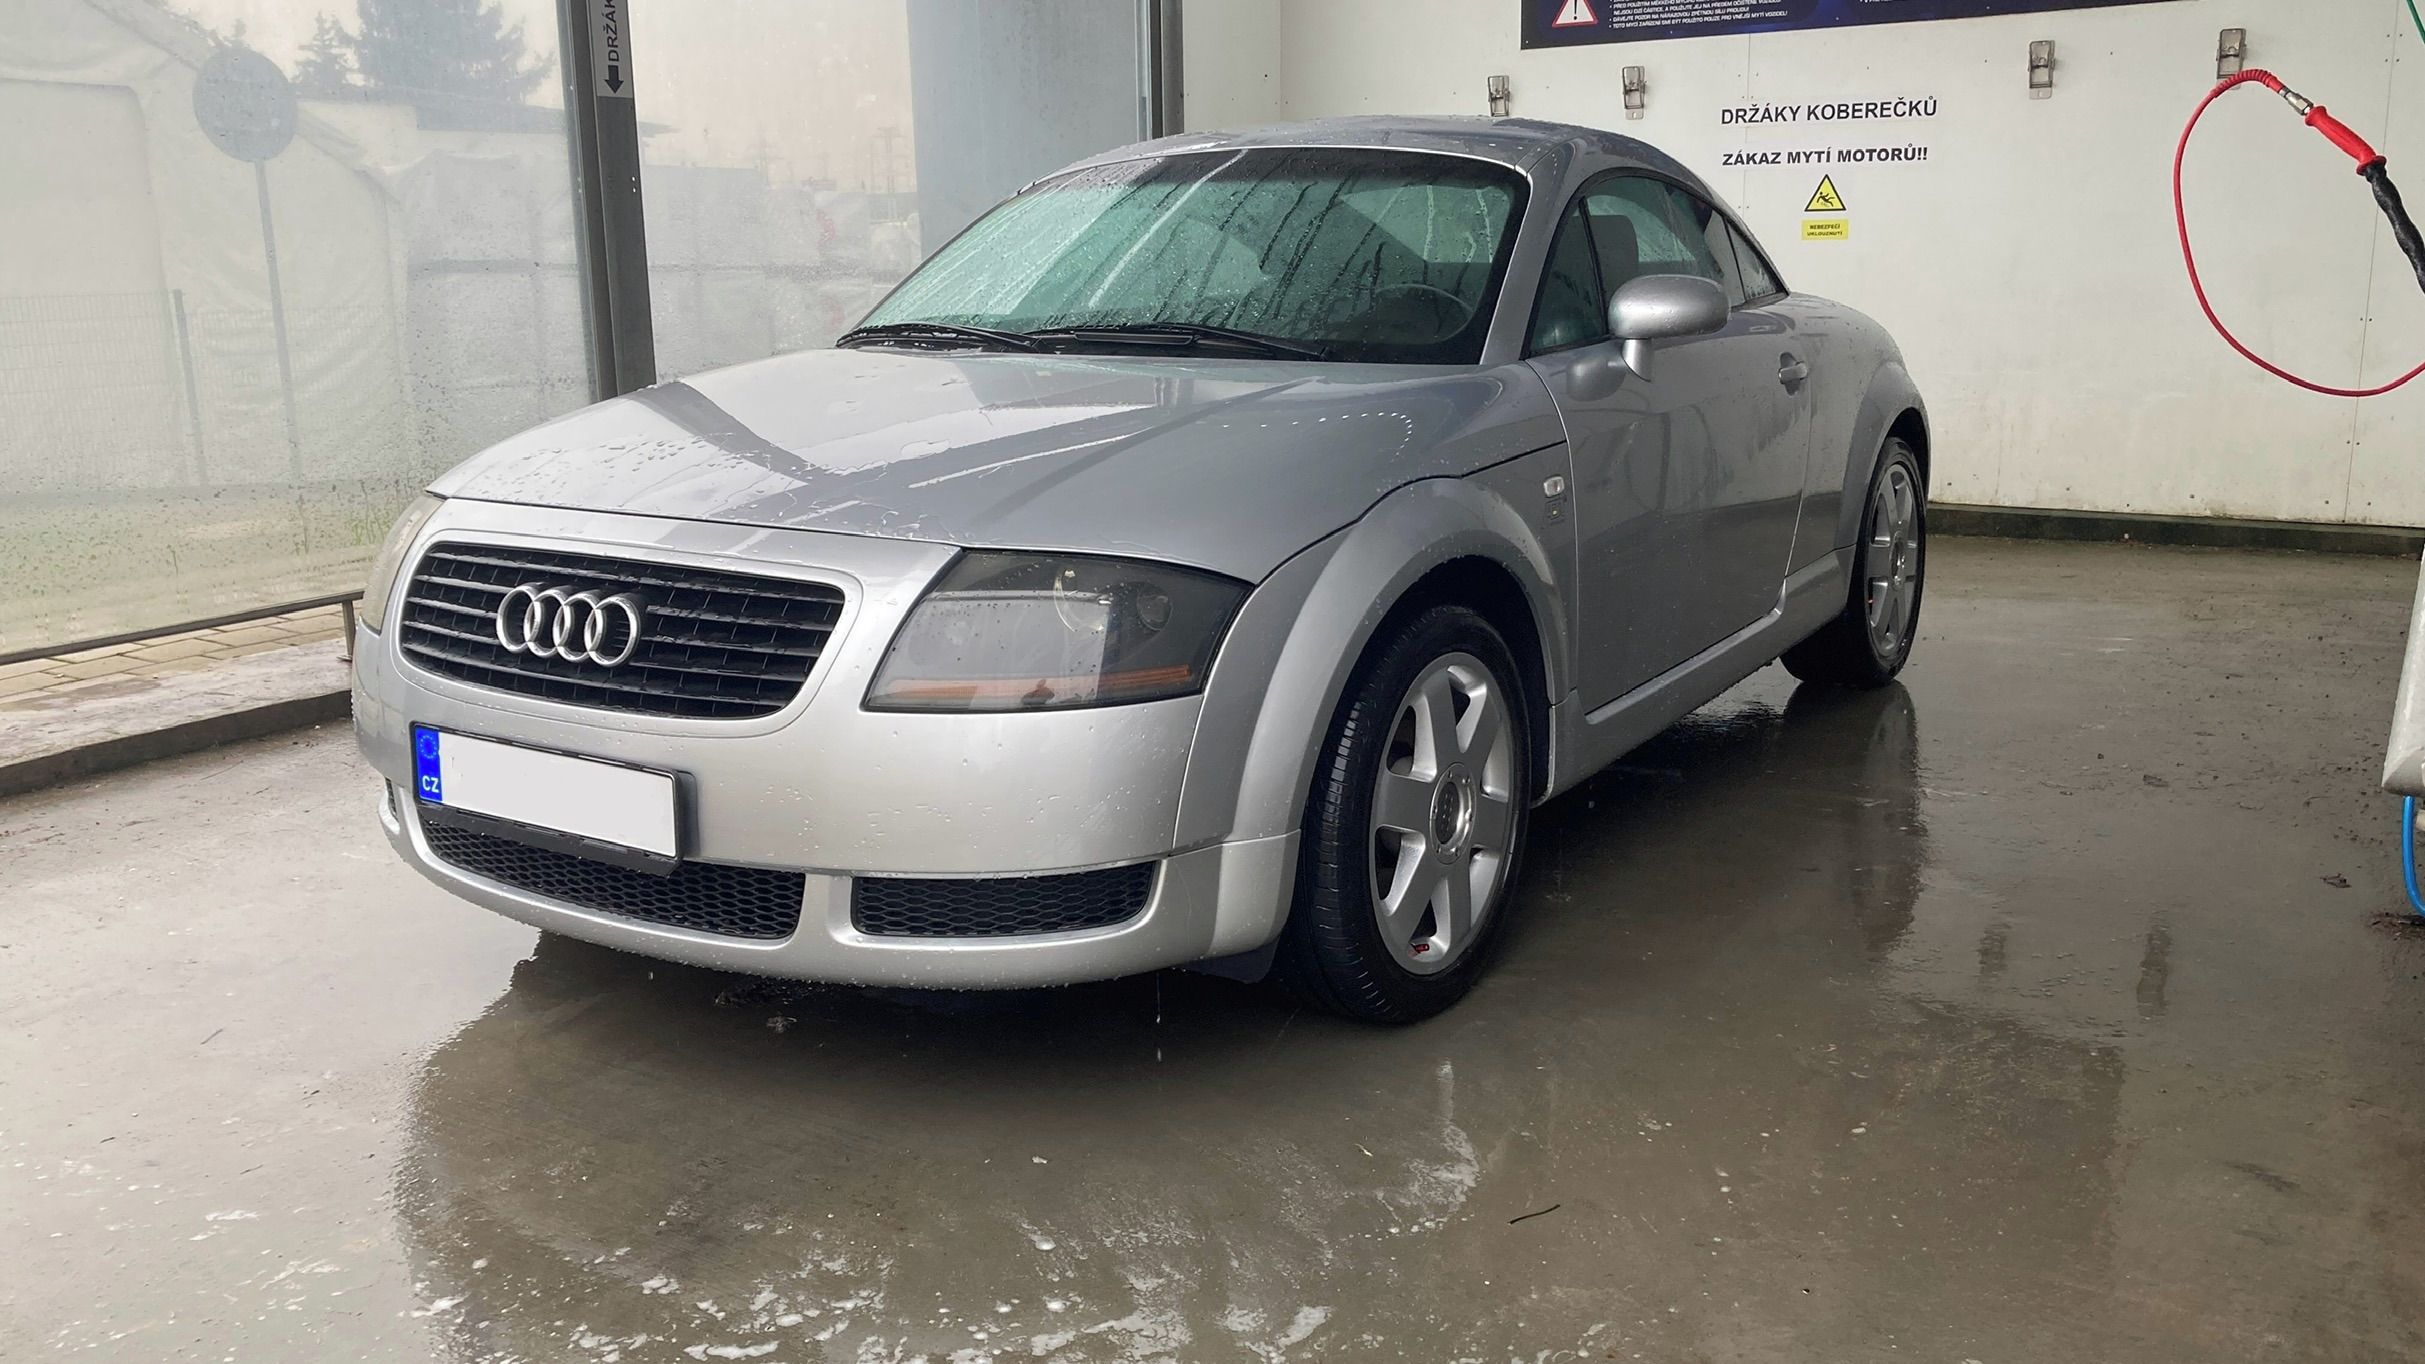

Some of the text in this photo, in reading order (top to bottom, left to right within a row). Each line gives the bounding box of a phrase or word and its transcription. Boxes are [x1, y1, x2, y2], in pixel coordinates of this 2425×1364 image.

[1721, 95, 1938, 124] DRŽÁKY KOBEREČKŮ
[1722, 143, 1928, 166] ZÁKAZ MYTÍ MOTORŮ!!
[422, 775, 440, 793] CZ
